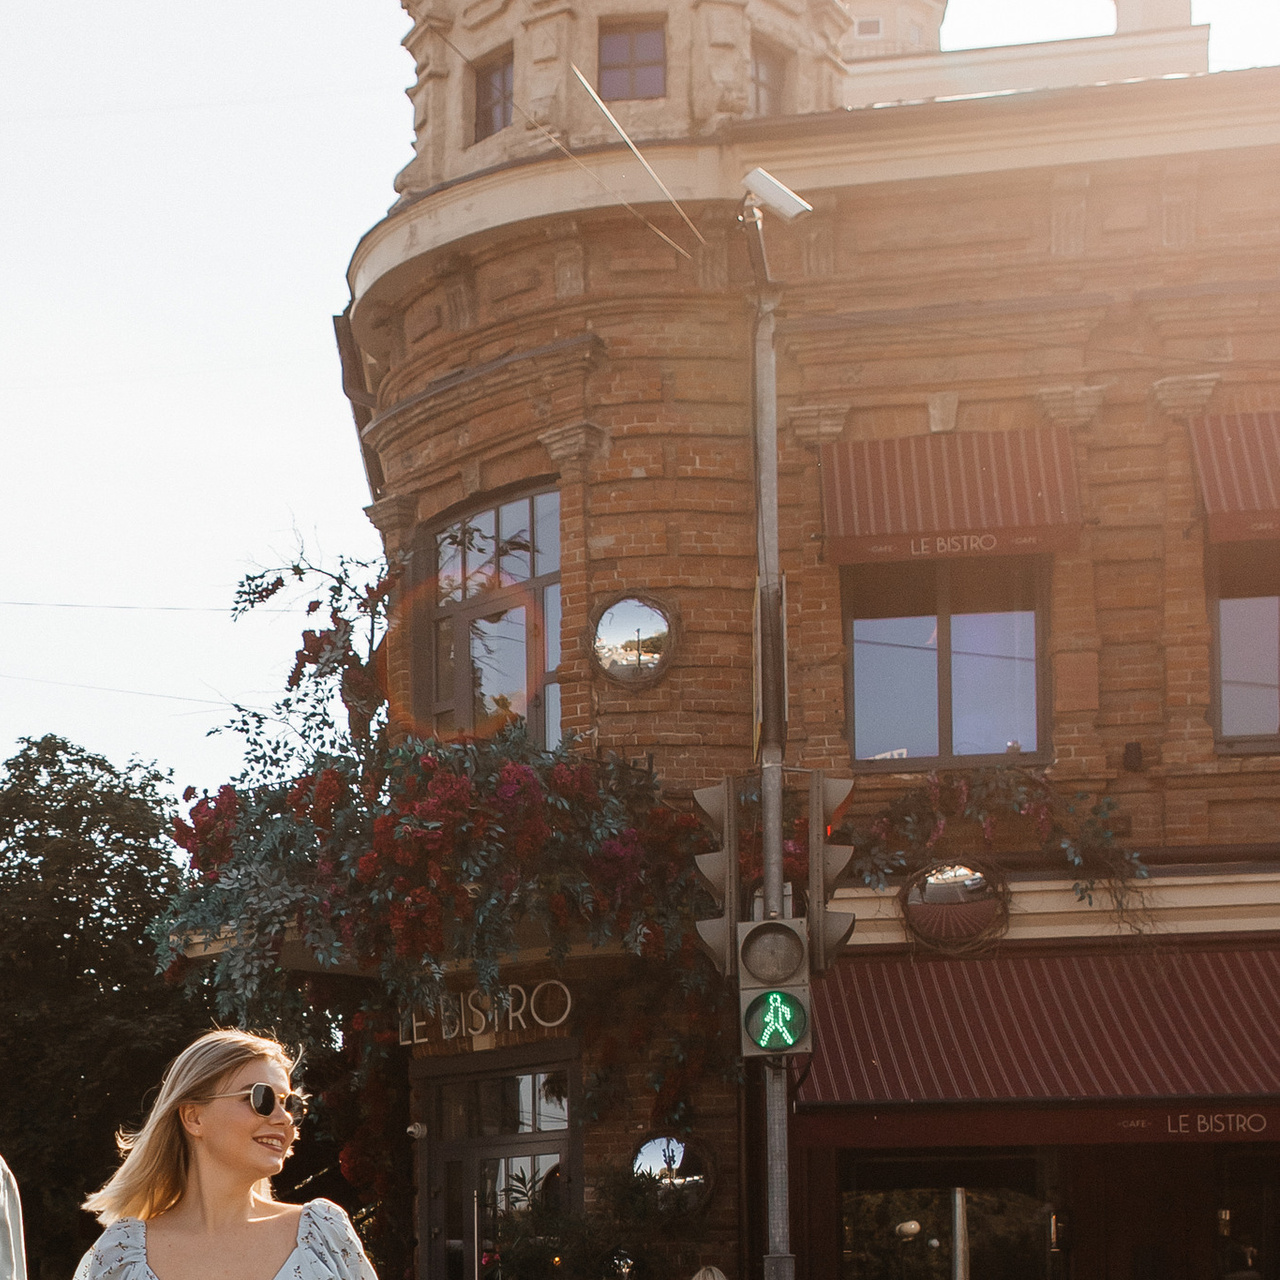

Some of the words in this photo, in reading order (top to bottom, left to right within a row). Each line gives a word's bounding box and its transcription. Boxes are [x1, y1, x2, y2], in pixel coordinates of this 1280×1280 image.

[911, 538, 931, 555] LE
[936, 534, 997, 553] BISTRO
[1167, 1114, 1190, 1133] LE
[1197, 1113, 1267, 1133] BISTRO
